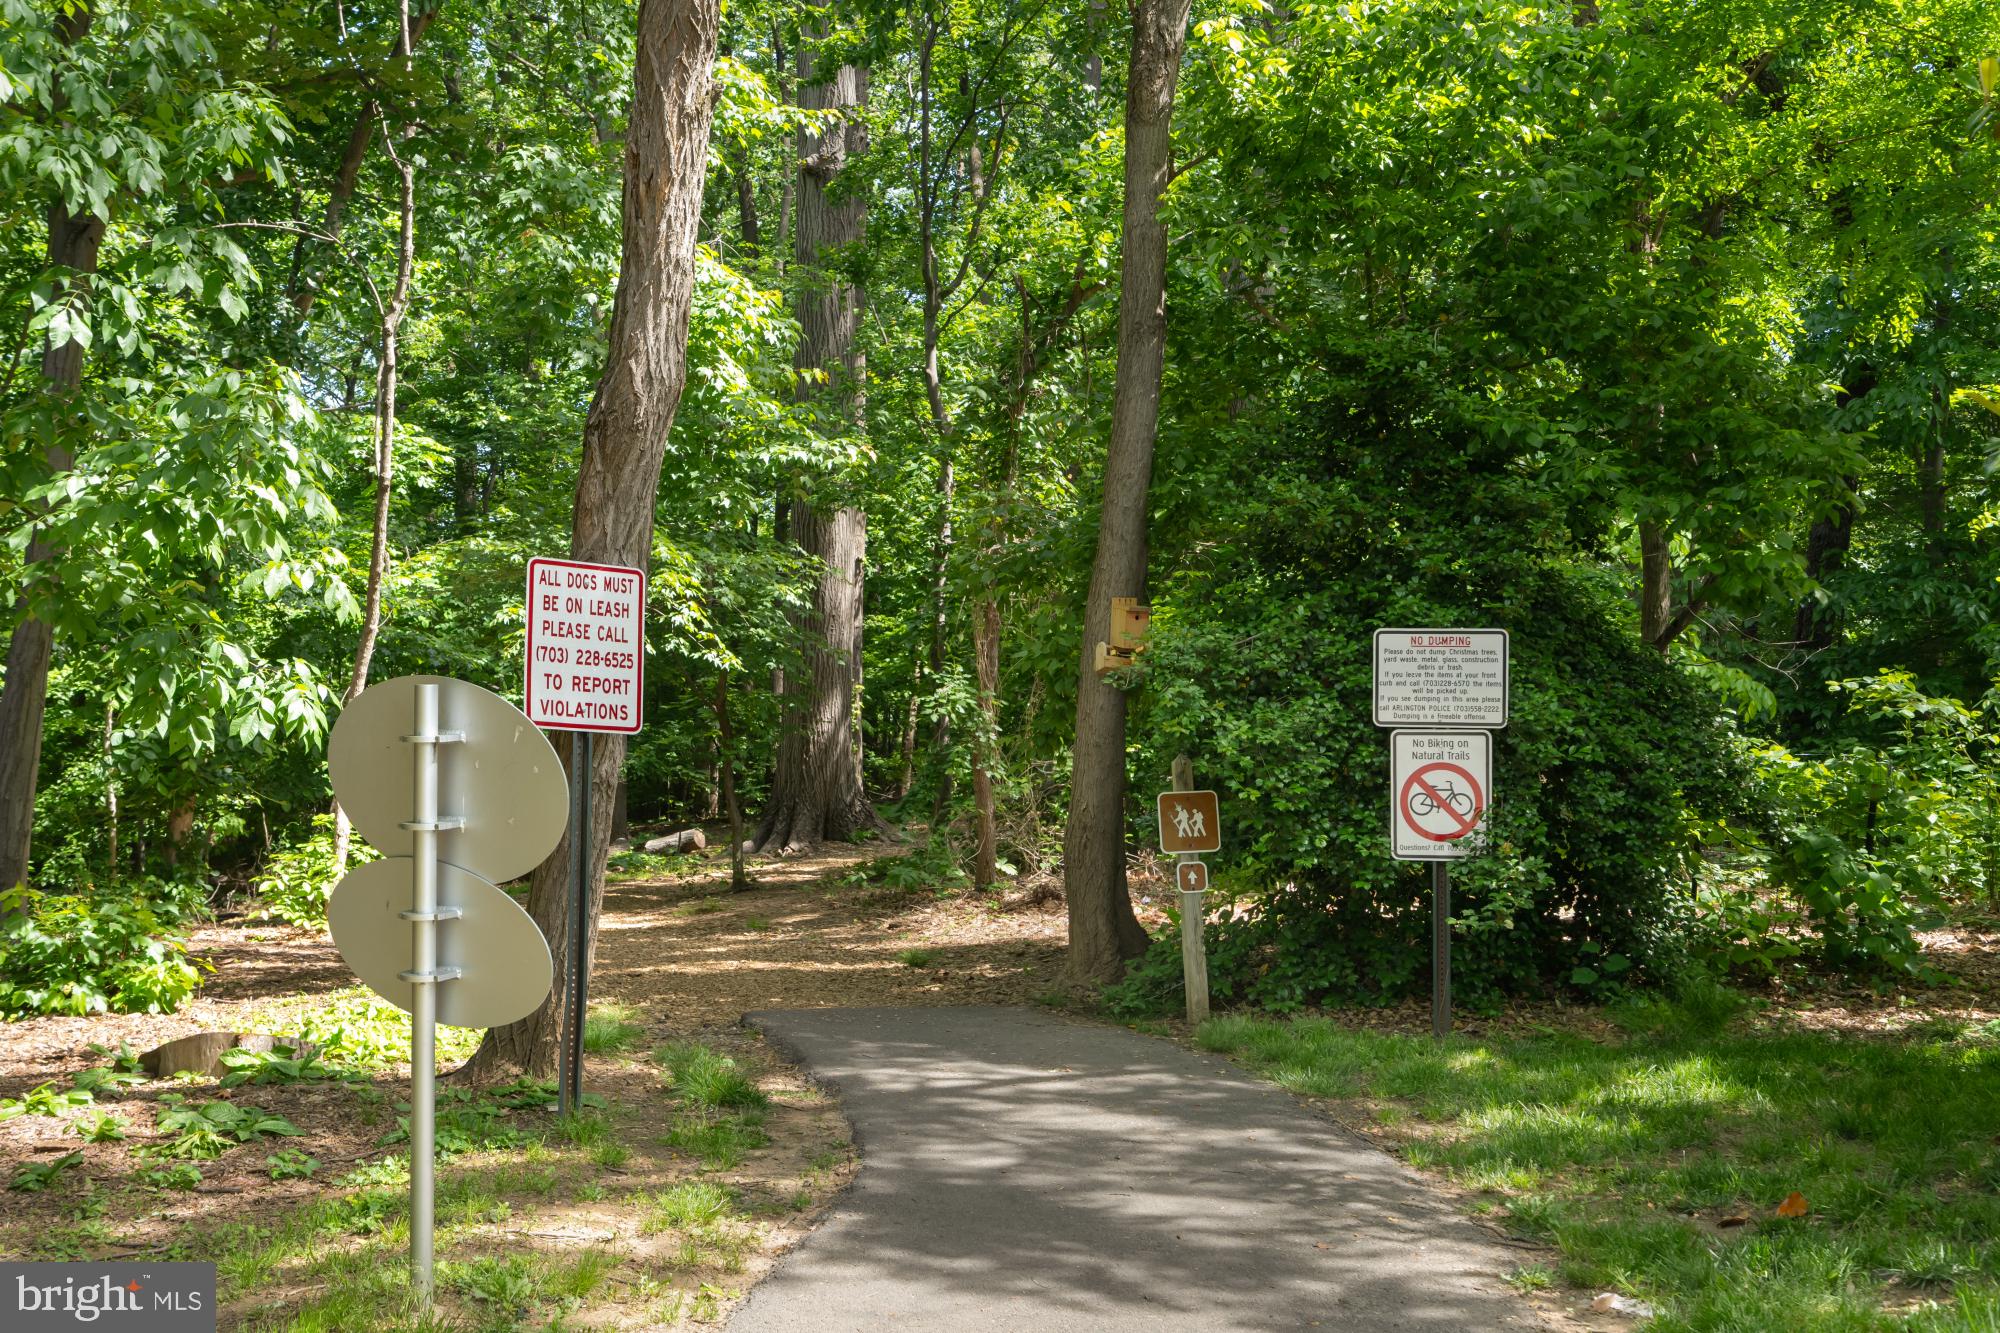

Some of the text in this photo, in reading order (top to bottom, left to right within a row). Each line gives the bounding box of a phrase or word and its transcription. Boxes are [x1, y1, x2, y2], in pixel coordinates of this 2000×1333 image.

[539, 569, 634, 595] ALL DOGS MUST
[543, 594, 630, 619] BE ON LEASH
[542, 620, 629, 644] PLEASE CALL
[1410, 636, 1471, 646] NO DUMPING
[536, 645, 634, 669] (703) 228-6525
[1449, 648, 1479, 656] Christmas
[1383, 656, 1397, 664] yard
[1461, 656, 1499, 664] construction
[543, 673, 631, 696] TO REPORT
[1413, 696, 1441, 704] dumping
[540, 698, 629, 721] VIOLATIONS
[1393, 712, 1420, 720] Dumping
[1412, 738, 1469, 750] No Biking on
[1411, 750, 1470, 760] Natural Trails
